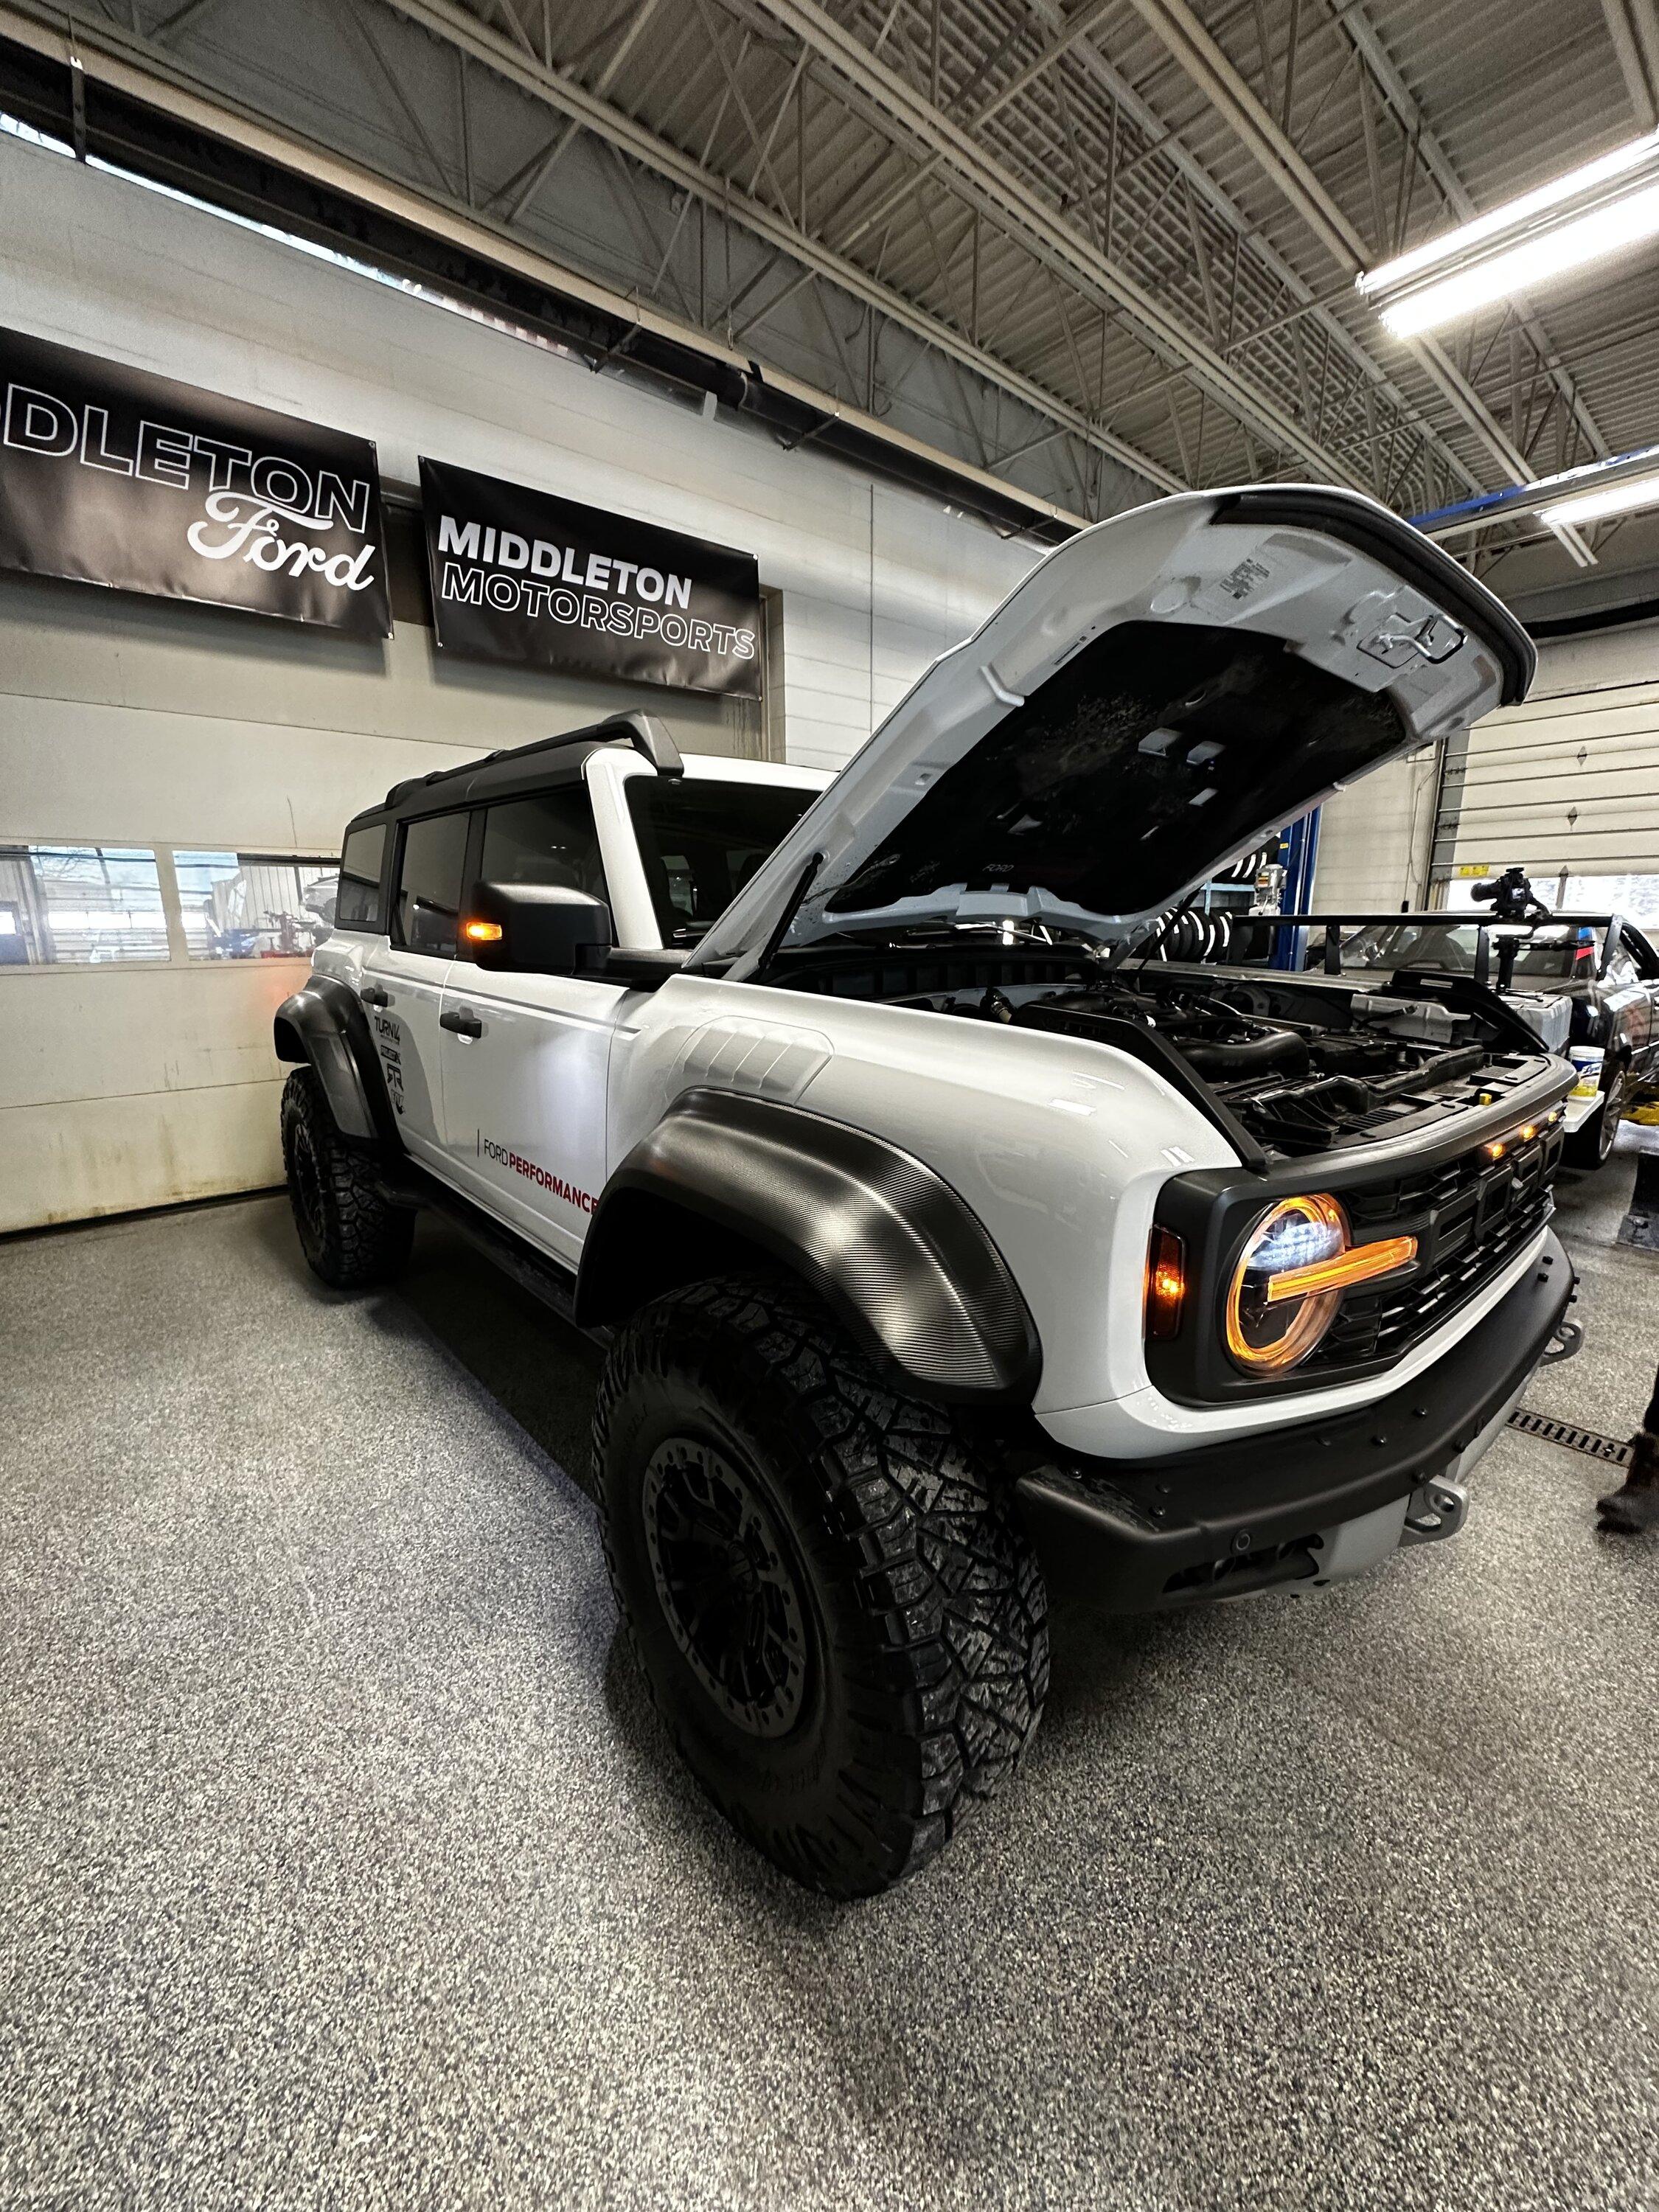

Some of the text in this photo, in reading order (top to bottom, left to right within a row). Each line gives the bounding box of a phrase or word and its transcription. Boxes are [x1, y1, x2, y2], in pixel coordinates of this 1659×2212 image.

[0, 383, 370, 534] DLETON
[187, 491, 376, 591] Ford
[438, 515, 692, 609] MIDDLETON
[441, 562, 756, 660] MOTORSPORTS
